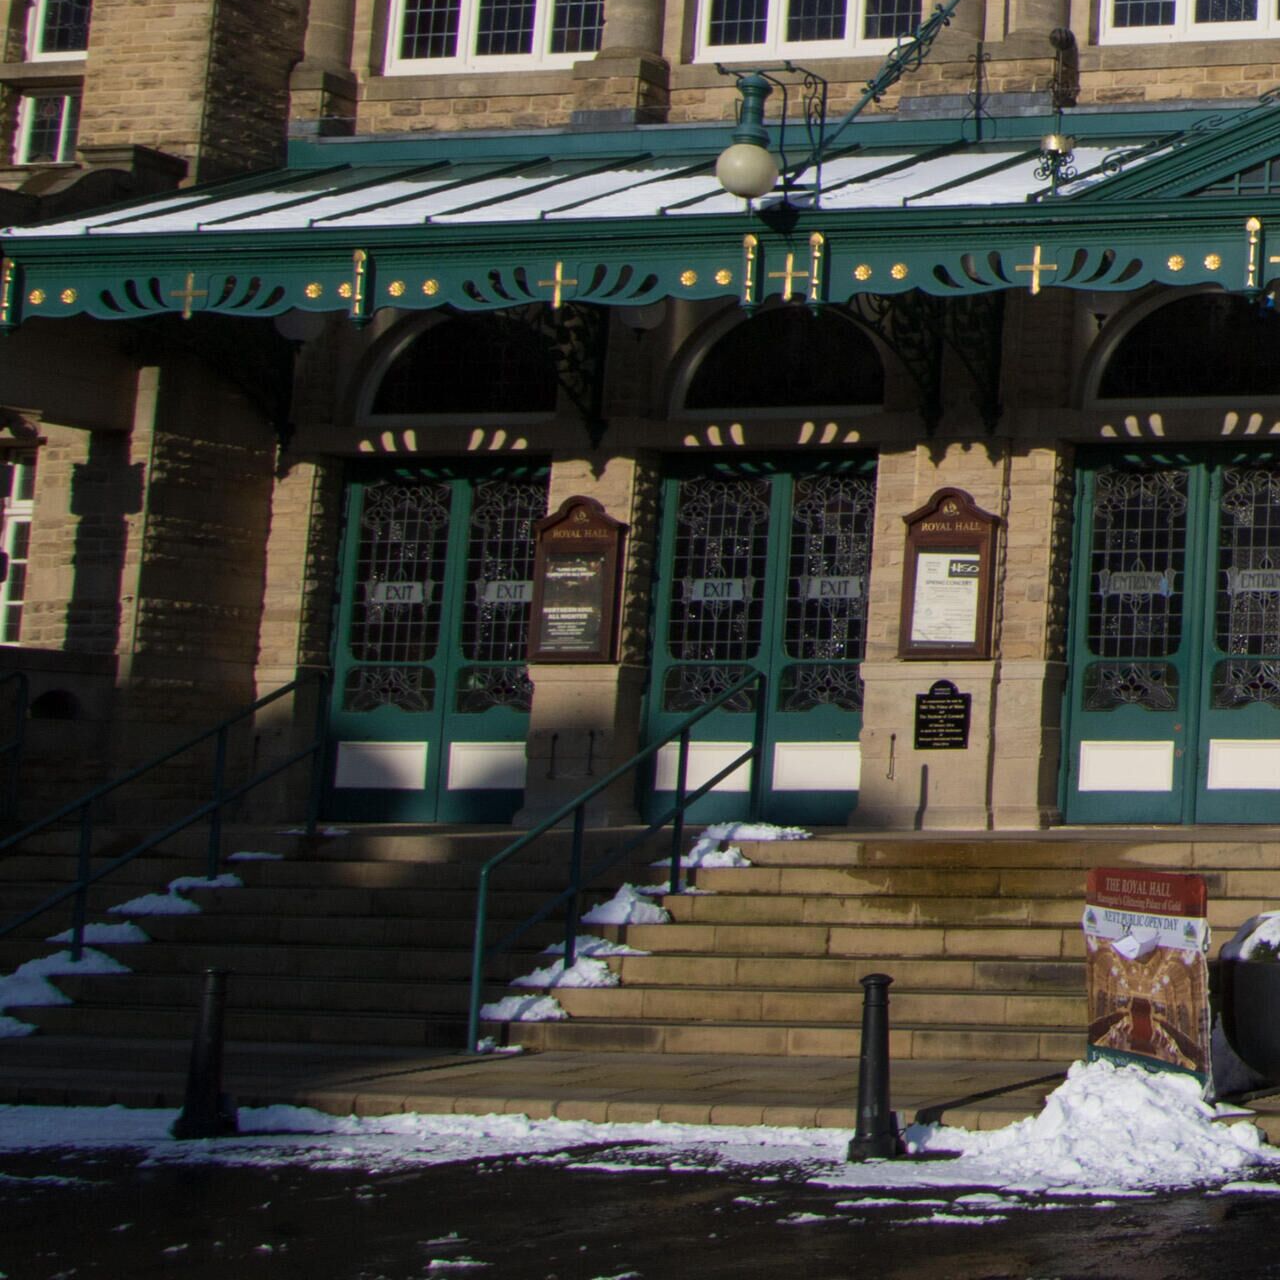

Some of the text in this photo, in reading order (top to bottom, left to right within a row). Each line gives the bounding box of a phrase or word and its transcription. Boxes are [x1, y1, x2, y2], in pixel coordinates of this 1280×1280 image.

[552, 529, 608, 538] ROYAL HALL
[921, 522, 981, 532] ROYAL HALL
[386, 585, 413, 600] EXIT
[497, 584, 525, 599] EXIT
[703, 582, 733, 597] EXIT
[820, 581, 850, 596] EXIT
